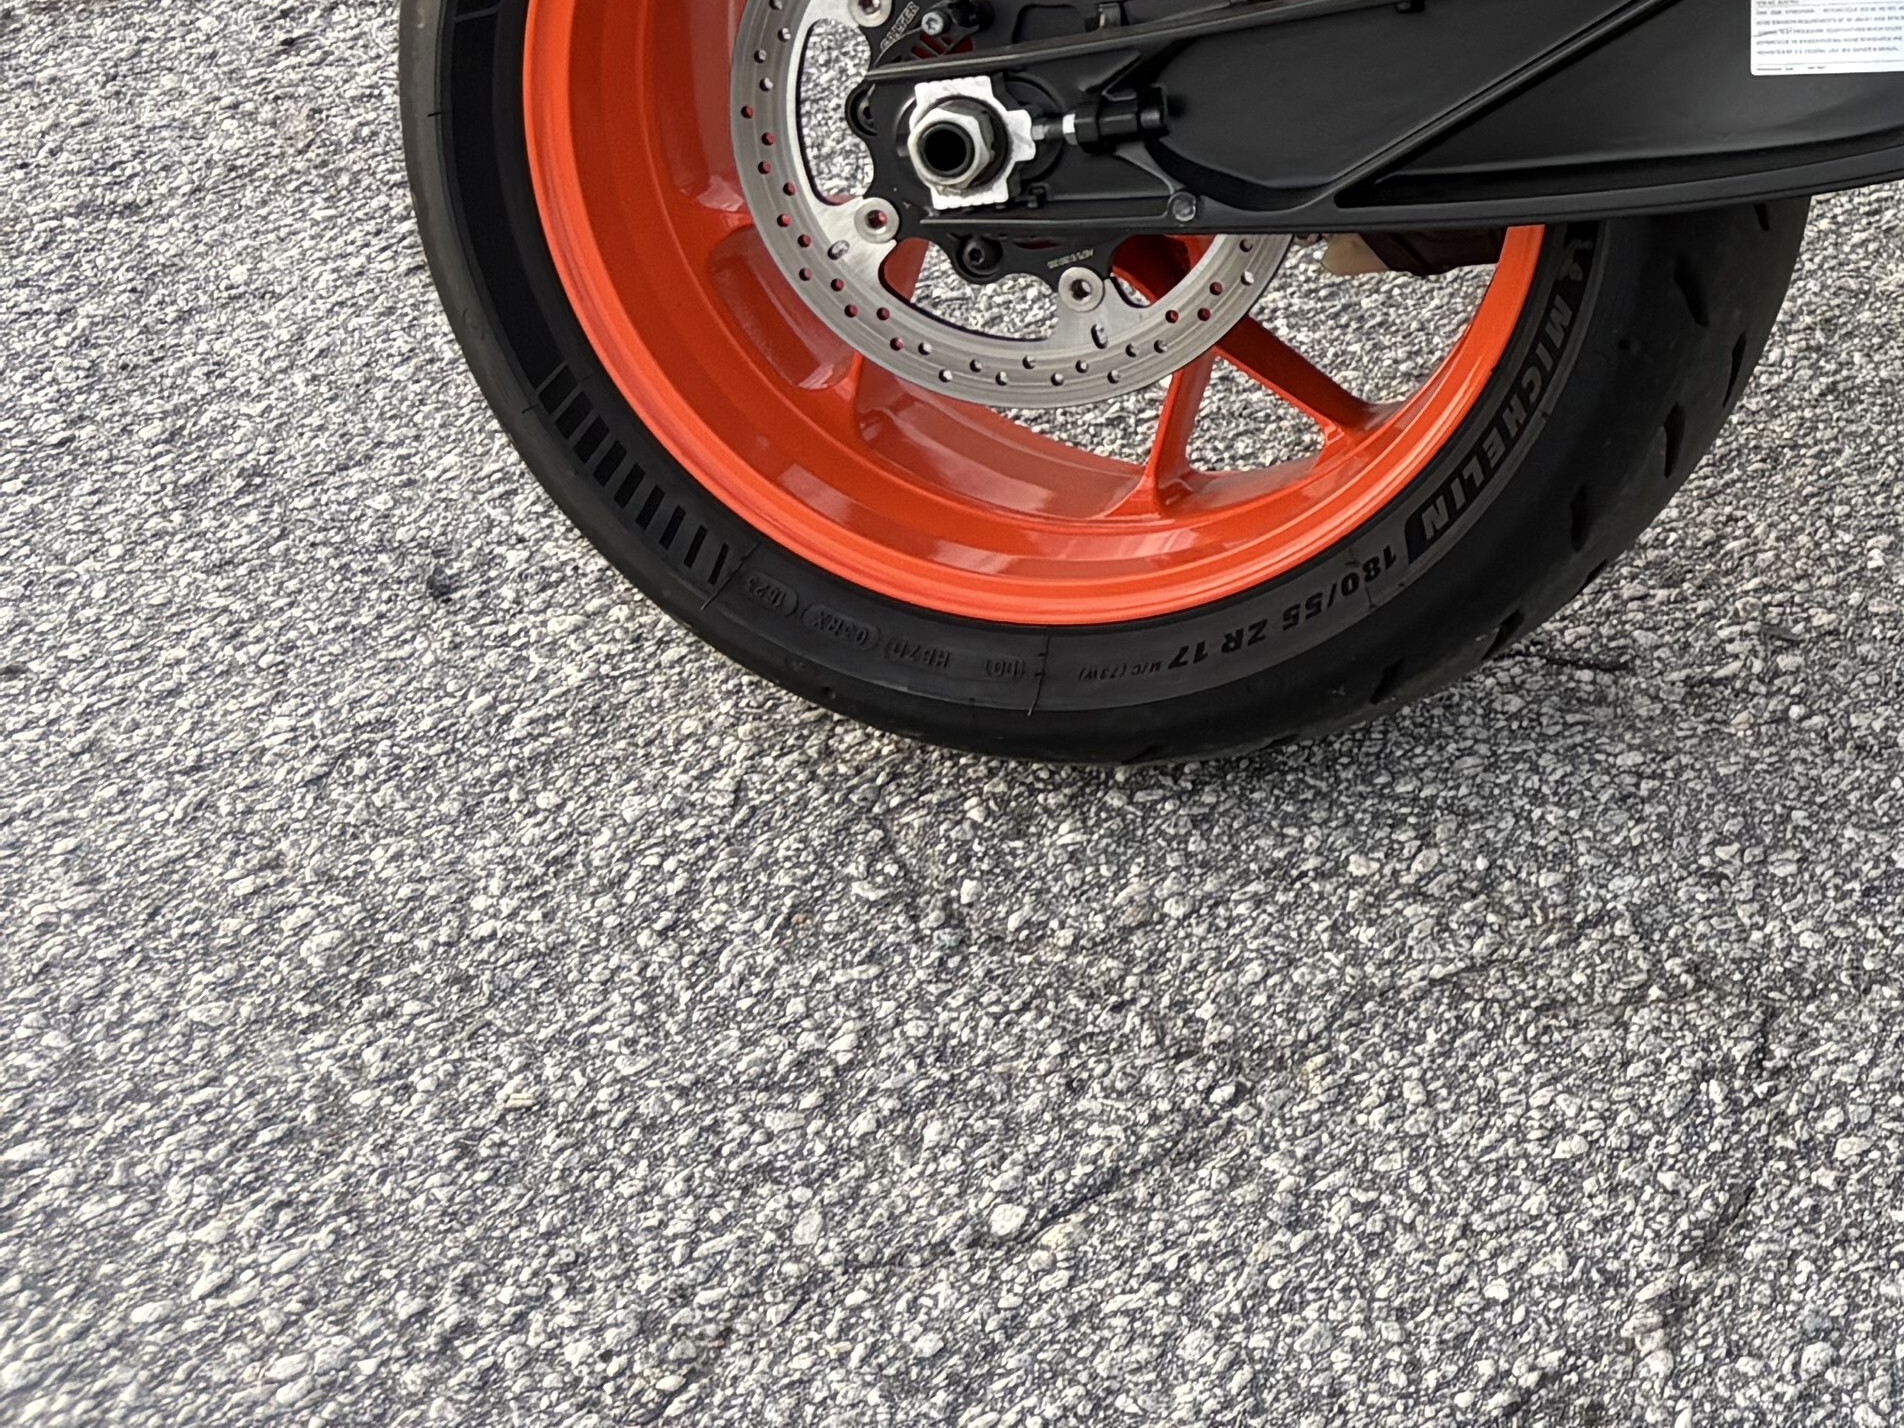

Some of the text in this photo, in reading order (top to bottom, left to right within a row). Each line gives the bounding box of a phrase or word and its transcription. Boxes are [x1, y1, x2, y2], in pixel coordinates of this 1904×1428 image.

[1420, 288, 1586, 539] MICHELIN
[1280, 546, 1398, 632] 180/55
[1166, 640, 1210, 671] 17
[1218, 617, 1268, 655] ZR
